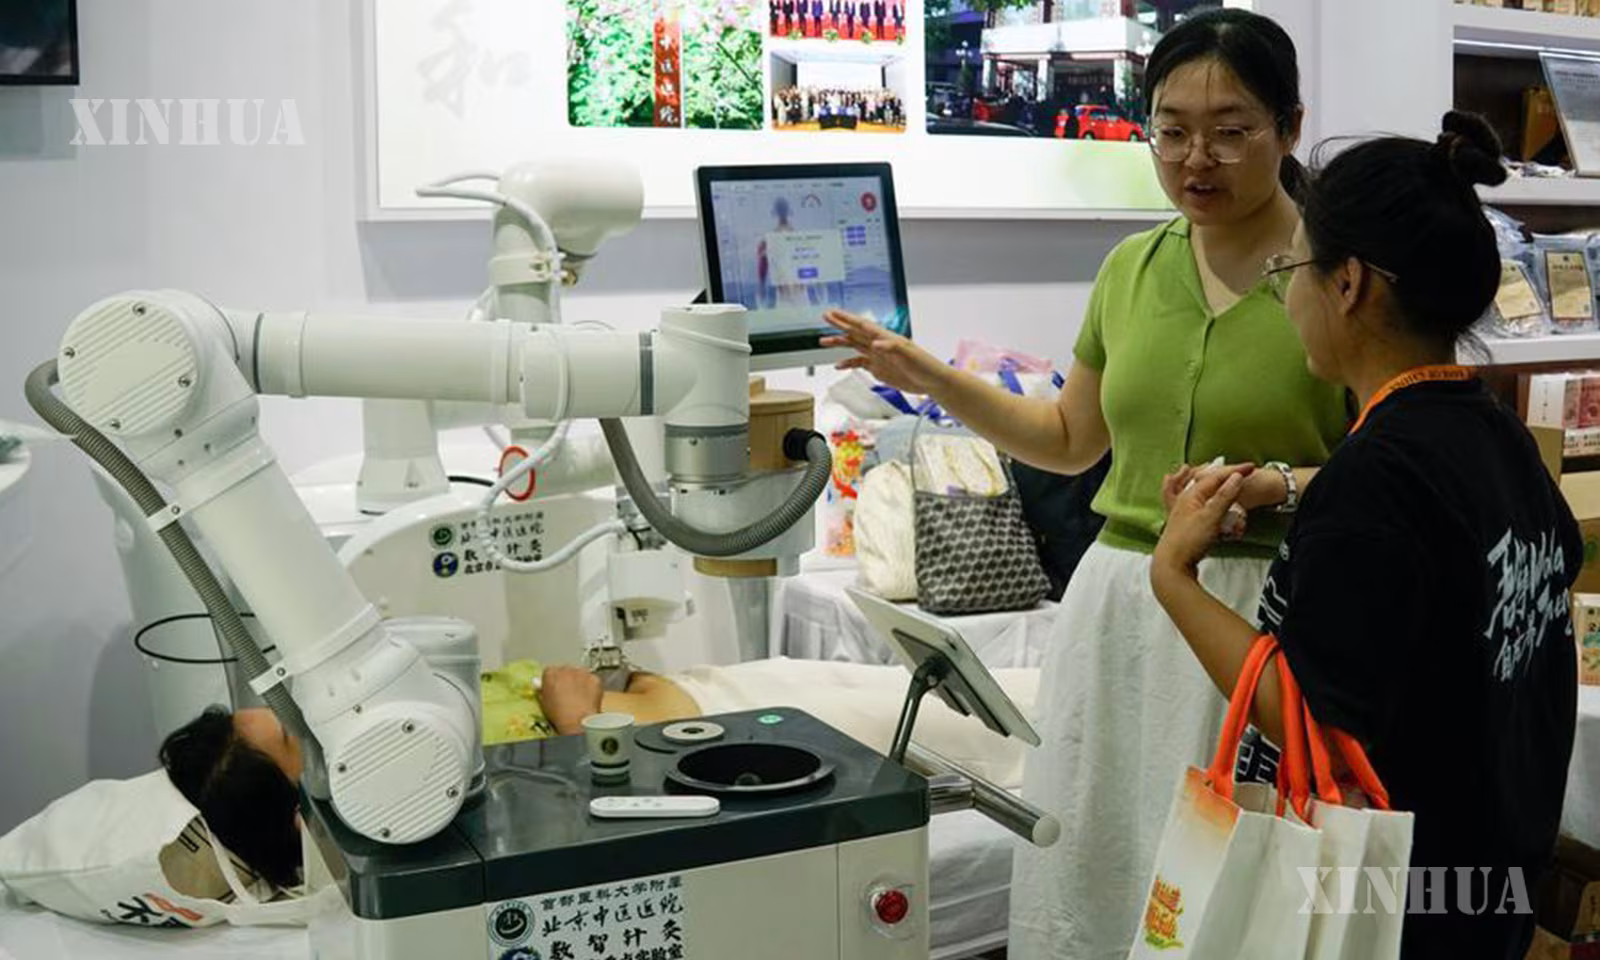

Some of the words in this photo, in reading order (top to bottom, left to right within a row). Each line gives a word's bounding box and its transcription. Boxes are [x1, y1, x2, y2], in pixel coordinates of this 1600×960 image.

[542, 892, 684, 937] 北京中医医院
